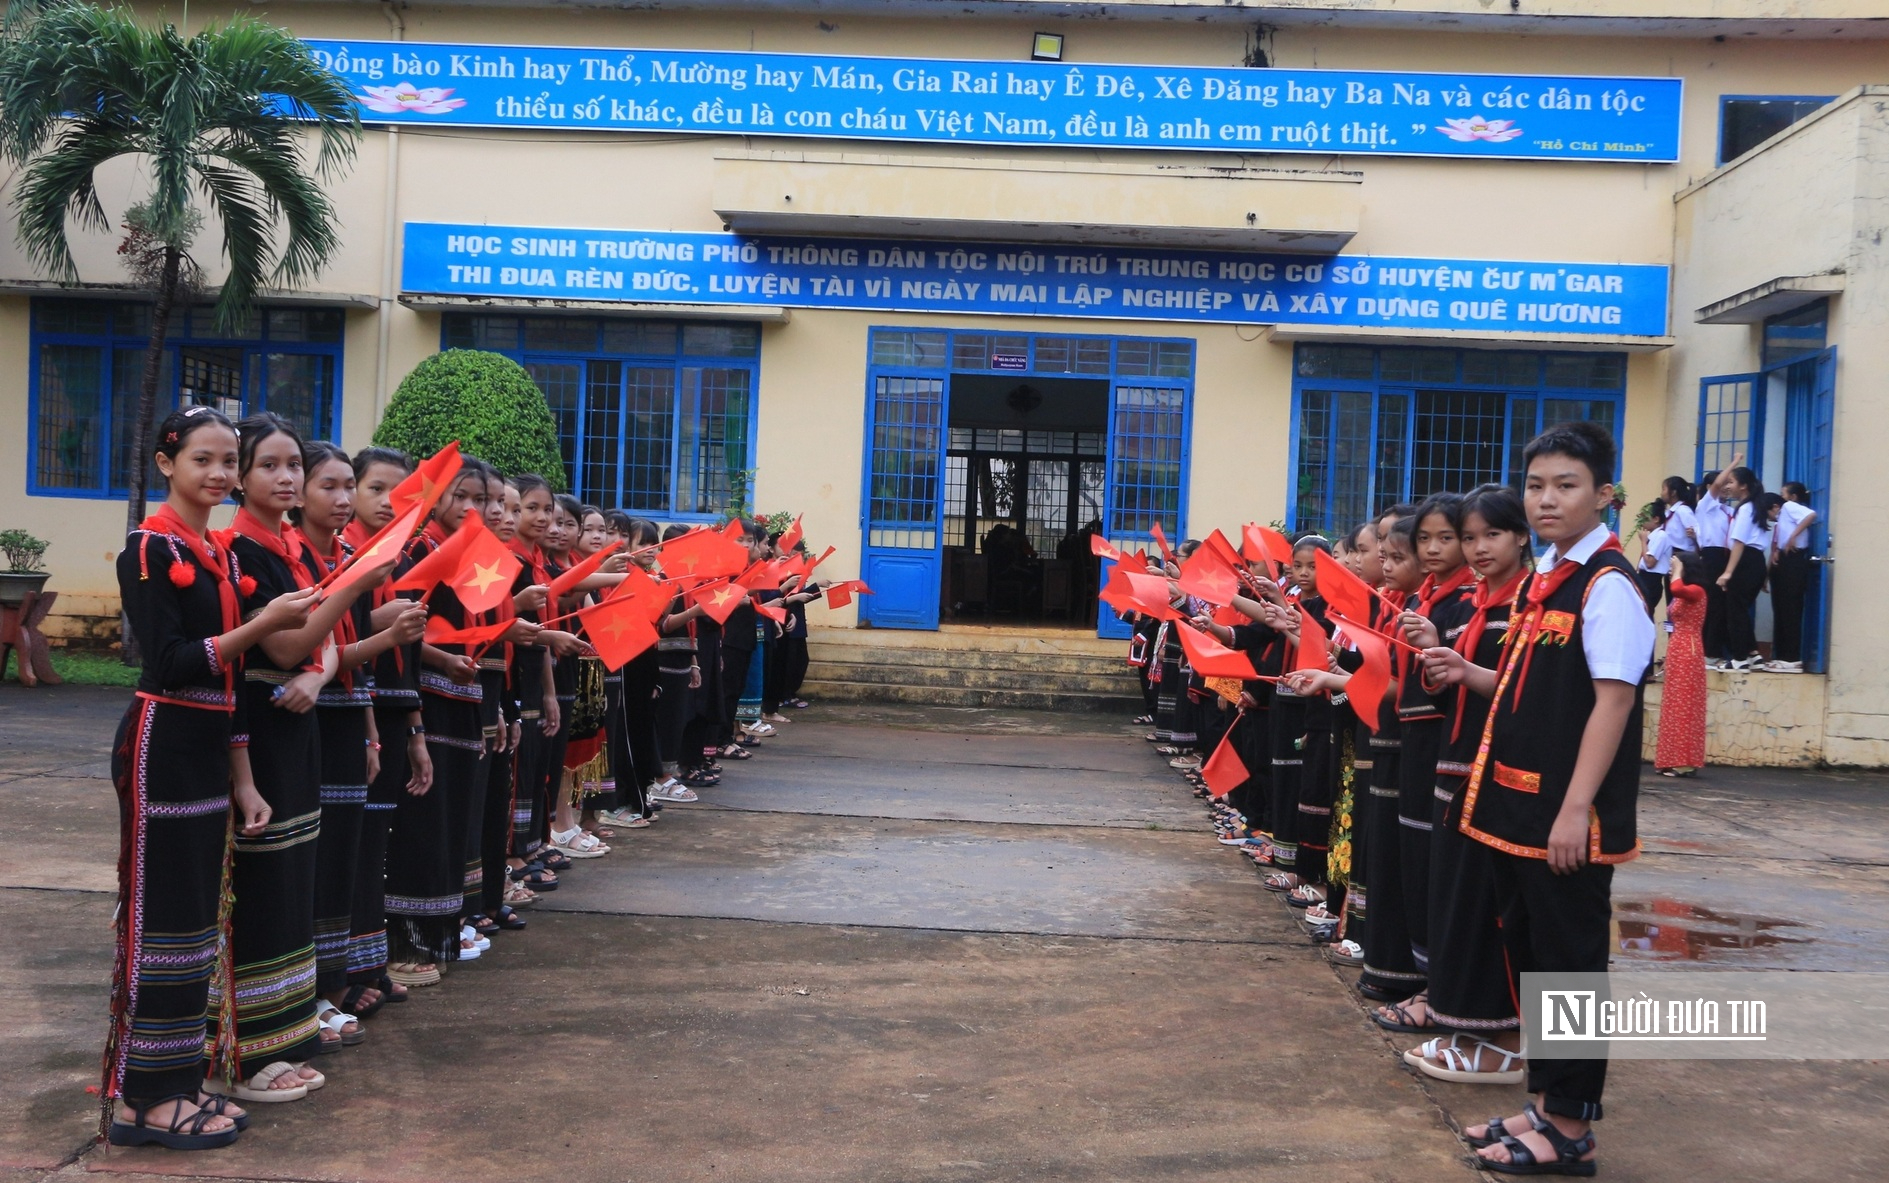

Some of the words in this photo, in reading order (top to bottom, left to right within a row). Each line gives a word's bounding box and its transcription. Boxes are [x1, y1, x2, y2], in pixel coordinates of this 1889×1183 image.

[393, 53, 440, 76] bào
[450, 55, 515, 78] Kinh
[524, 57, 571, 85] hay
[580, 54, 641, 85] Thổ,
[650, 61, 747, 90] Mường
[755, 64, 803, 92] hay
[812, 66, 883, 94] Mán,
[893, 69, 941, 92] Gia
[951, 71, 997, 94] Rai
[1006, 72, 1056, 101] hay
[1064, 67, 1084, 96] Ê
[1096, 75, 1145, 102] Đê,
[1154, 76, 1192, 99] Xê
[1203, 78, 1278, 107] Đăng
[1287, 80, 1336, 109] hay
[1345, 82, 1383, 105] Ba
[1392, 83, 1430, 106] Na
[1441, 84, 1472, 107] và
[1482, 85, 1529, 108] các
[1539, 87, 1591, 110] dân
[1601, 89, 1645, 116] tộc
[496, 91, 565, 119] thiểu
[573, 95, 605, 120] số
[610, 99, 683, 126] khác,
[692, 97, 743, 124] đều
[751, 103, 774, 126] là
[784, 110, 832, 127] con
[840, 107, 907, 130] cháu
[916, 109, 974, 137] Việt
[983, 112, 1056, 140] Nam,
[1065, 110, 1117, 137] đều
[1125, 115, 1149, 138] là
[1159, 118, 1210, 139] anh
[1219, 124, 1261, 141] em
[1271, 121, 1331, 147] ruột
[1341, 122, 1397, 149] thịt.
[1569, 141, 1598, 151] Chí
[448, 235, 502, 257] HỌC
[510, 237, 577, 257] SINH
[584, 238, 694, 261] TRƯỜNG
[703, 239, 760, 263] PHỔ
[768, 245, 858, 266] THÔNG
[868, 247, 925, 268] DÂN
[935, 249, 987, 273] TỘC
[997, 251, 1045, 276] NỘI
[1054, 254, 1107, 274] TRÚ
[1117, 258, 1209, 278] TRUNG
[1219, 262, 1275, 284] HỌC
[1285, 264, 1323, 283] CƠ
[1332, 261, 1371, 285] SỞ
[1379, 266, 1473, 291] HUYỆN
[447, 265, 491, 284] THI
[500, 267, 557, 287] ĐUA
[565, 267, 623, 289] RÈN
[632, 269, 699, 294] ĐỨC,
[709, 273, 800, 298] LUYỆN
[809, 275, 854, 297] TÀI
[864, 277, 891, 298] VÌ
[901, 278, 981, 301] NGÀY
[990, 283, 1047, 303] MAI
[1057, 283, 1113, 308] LẬP
[1122, 288, 1232, 313] NGHIỆP
[1242, 290, 1280, 312] VÀ
[1289, 292, 1348, 315] XÂY
[1357, 297, 1439, 320] DỰNG
[1449, 299, 1507, 321] QUÊ
[1517, 303, 1621, 324] HƯƠNG
